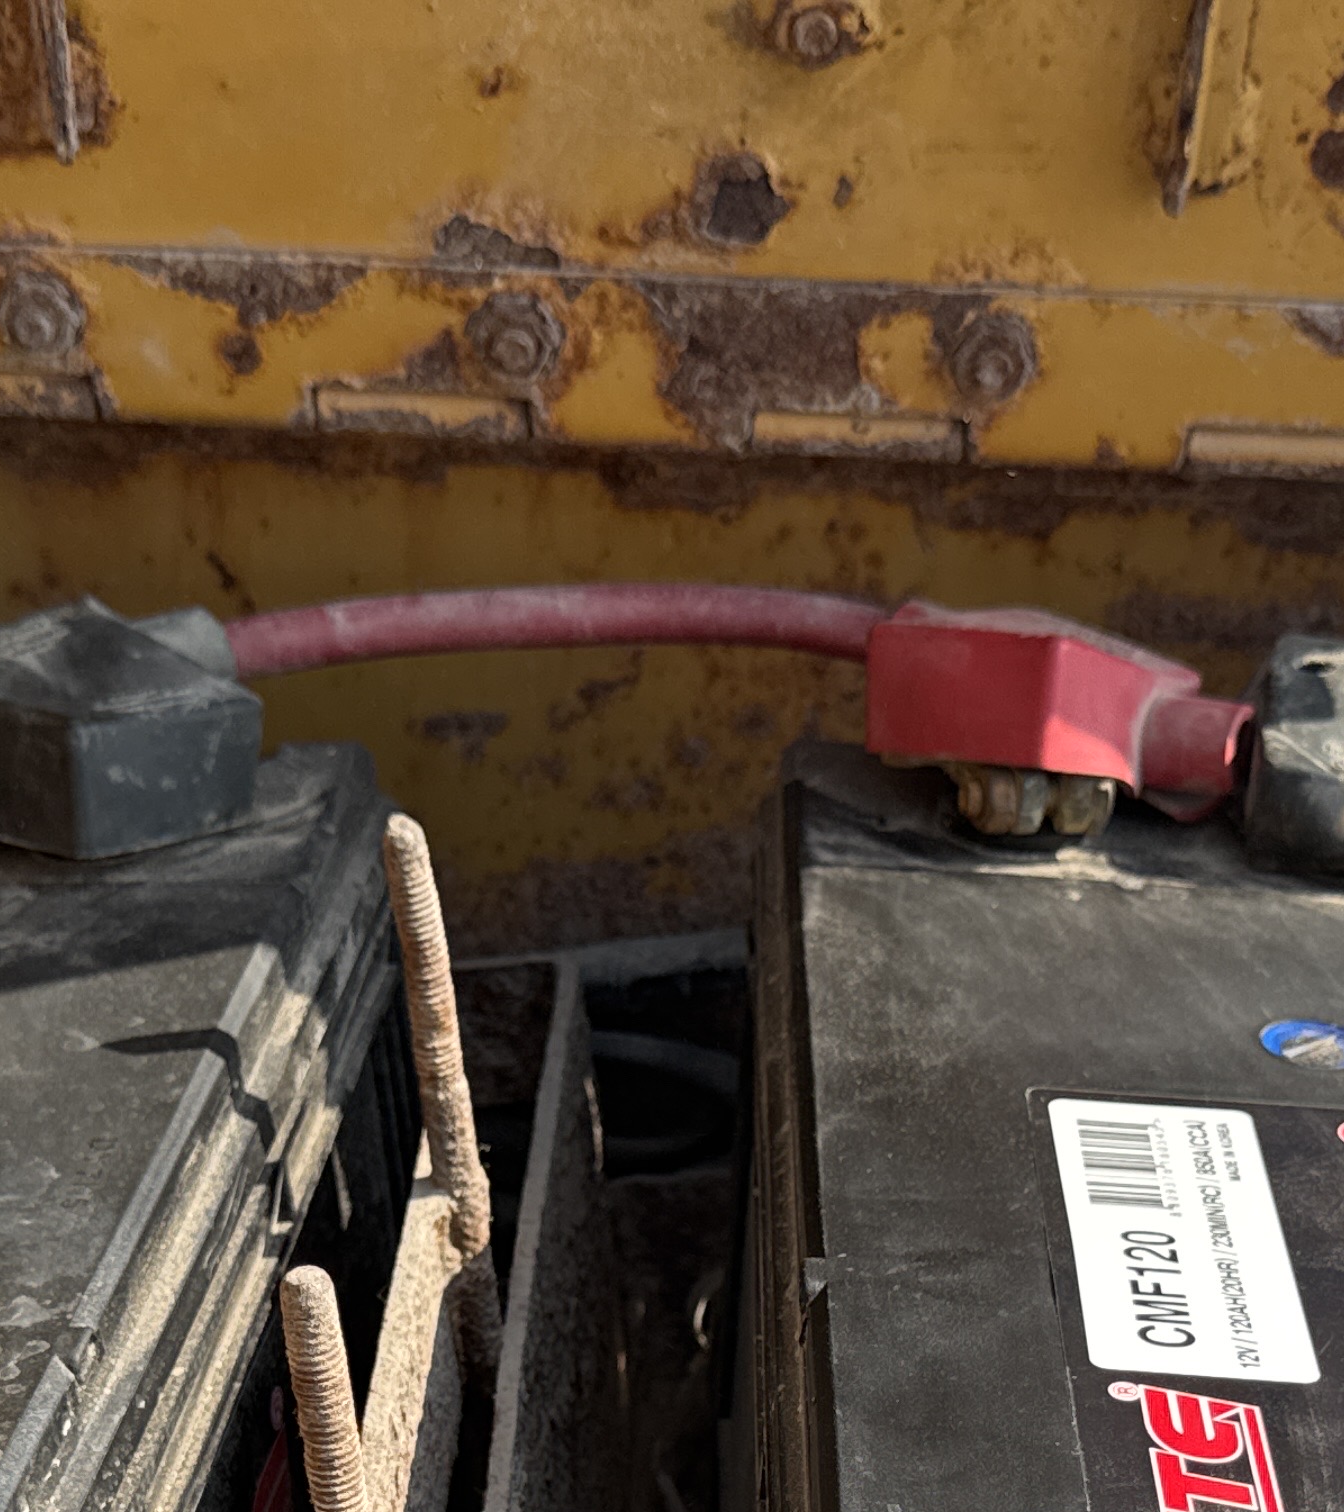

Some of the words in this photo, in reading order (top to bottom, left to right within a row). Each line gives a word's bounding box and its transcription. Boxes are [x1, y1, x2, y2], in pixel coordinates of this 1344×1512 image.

[1196, 1184, 1234, 1248] 230MIN(RC)
[1120, 1229, 1196, 1348] CMF120
[1213, 1257, 1253, 1335] 120AH(20HR)
[1235, 1346, 1261, 1368] 12V
